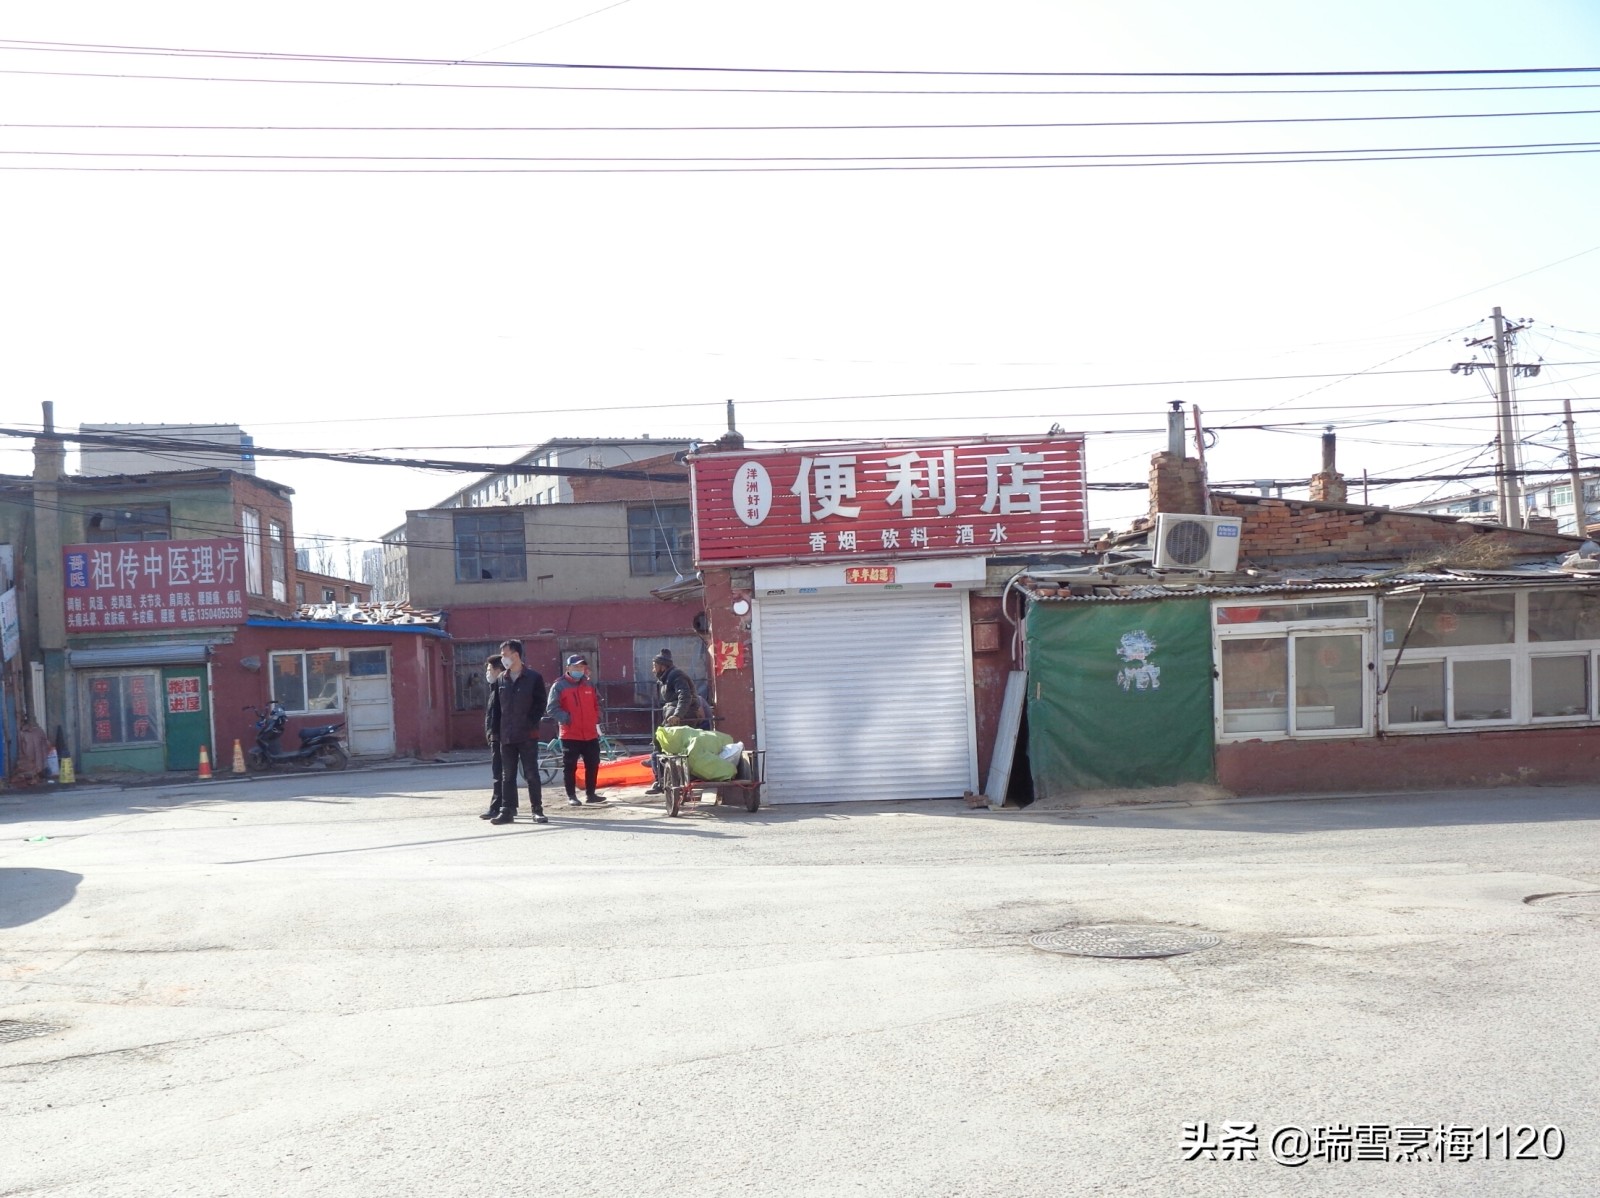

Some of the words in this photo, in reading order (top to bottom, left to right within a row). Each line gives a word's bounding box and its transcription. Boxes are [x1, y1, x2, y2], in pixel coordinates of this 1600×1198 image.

[746, 468, 760, 520] 洋洲好利
[790, 446, 1044, 524] 便利店
[809, 531, 857, 552] 香烟
[881, 526, 929, 549] 饮料
[955, 522, 1008, 545] 酒水
[91, 543, 239, 591] 祖传中医理疗
